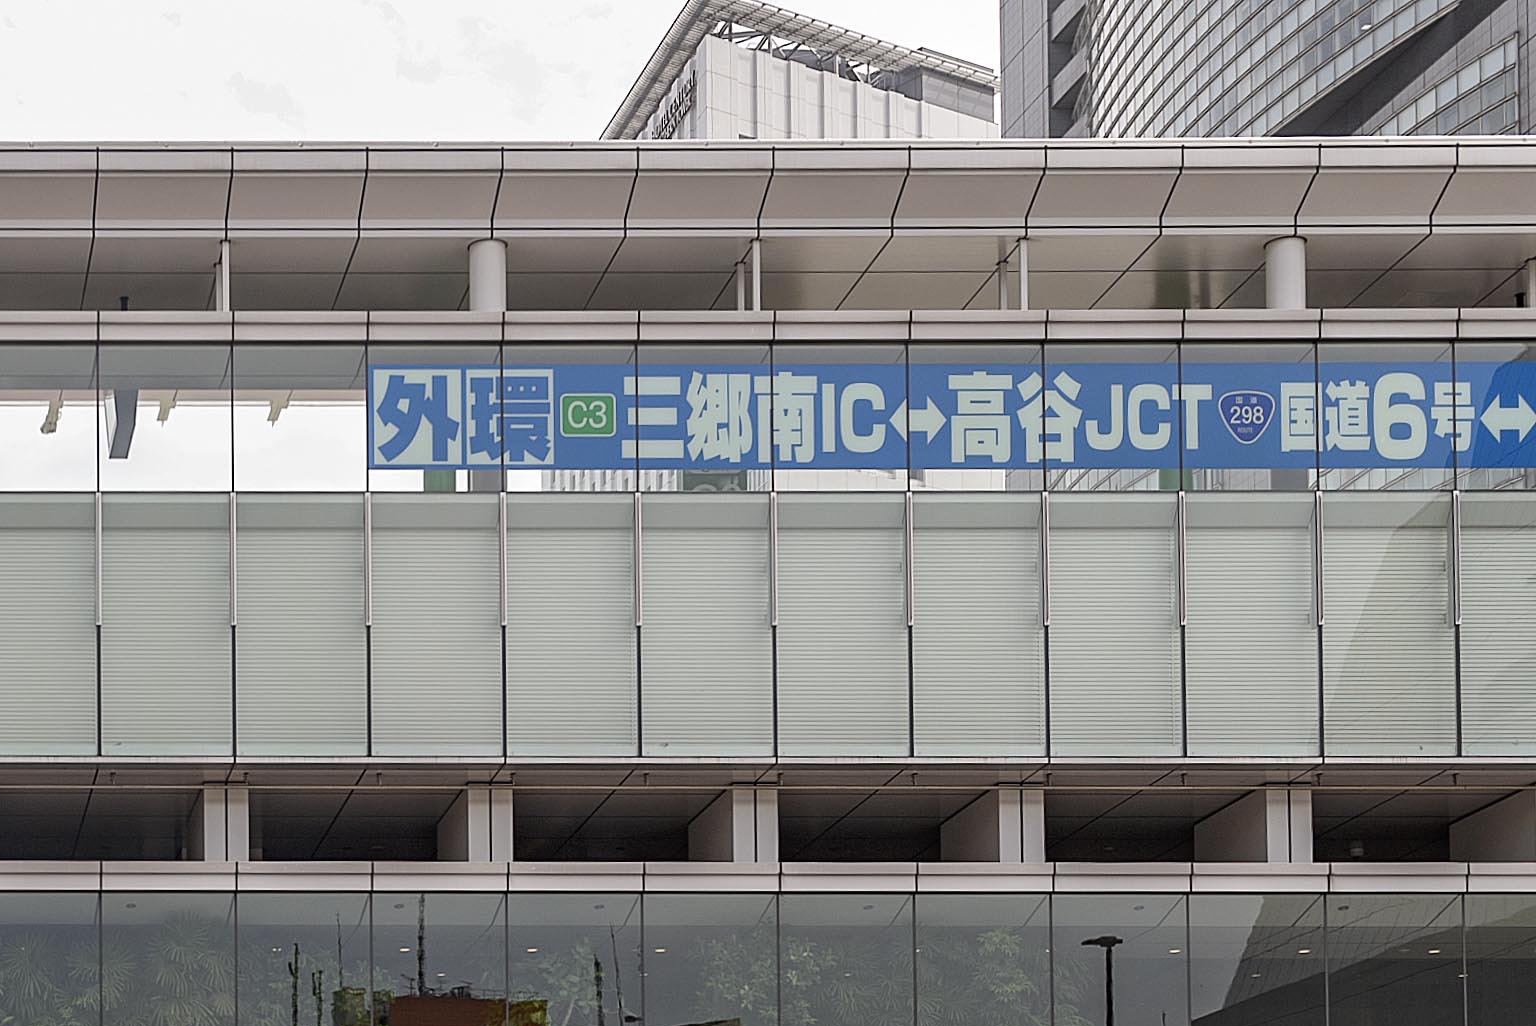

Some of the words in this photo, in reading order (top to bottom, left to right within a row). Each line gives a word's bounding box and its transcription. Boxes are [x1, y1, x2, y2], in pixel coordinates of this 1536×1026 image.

[374, 369, 554, 465] 外環
[567, 400, 608, 429] C3
[1229, 405, 1265, 424] 298
